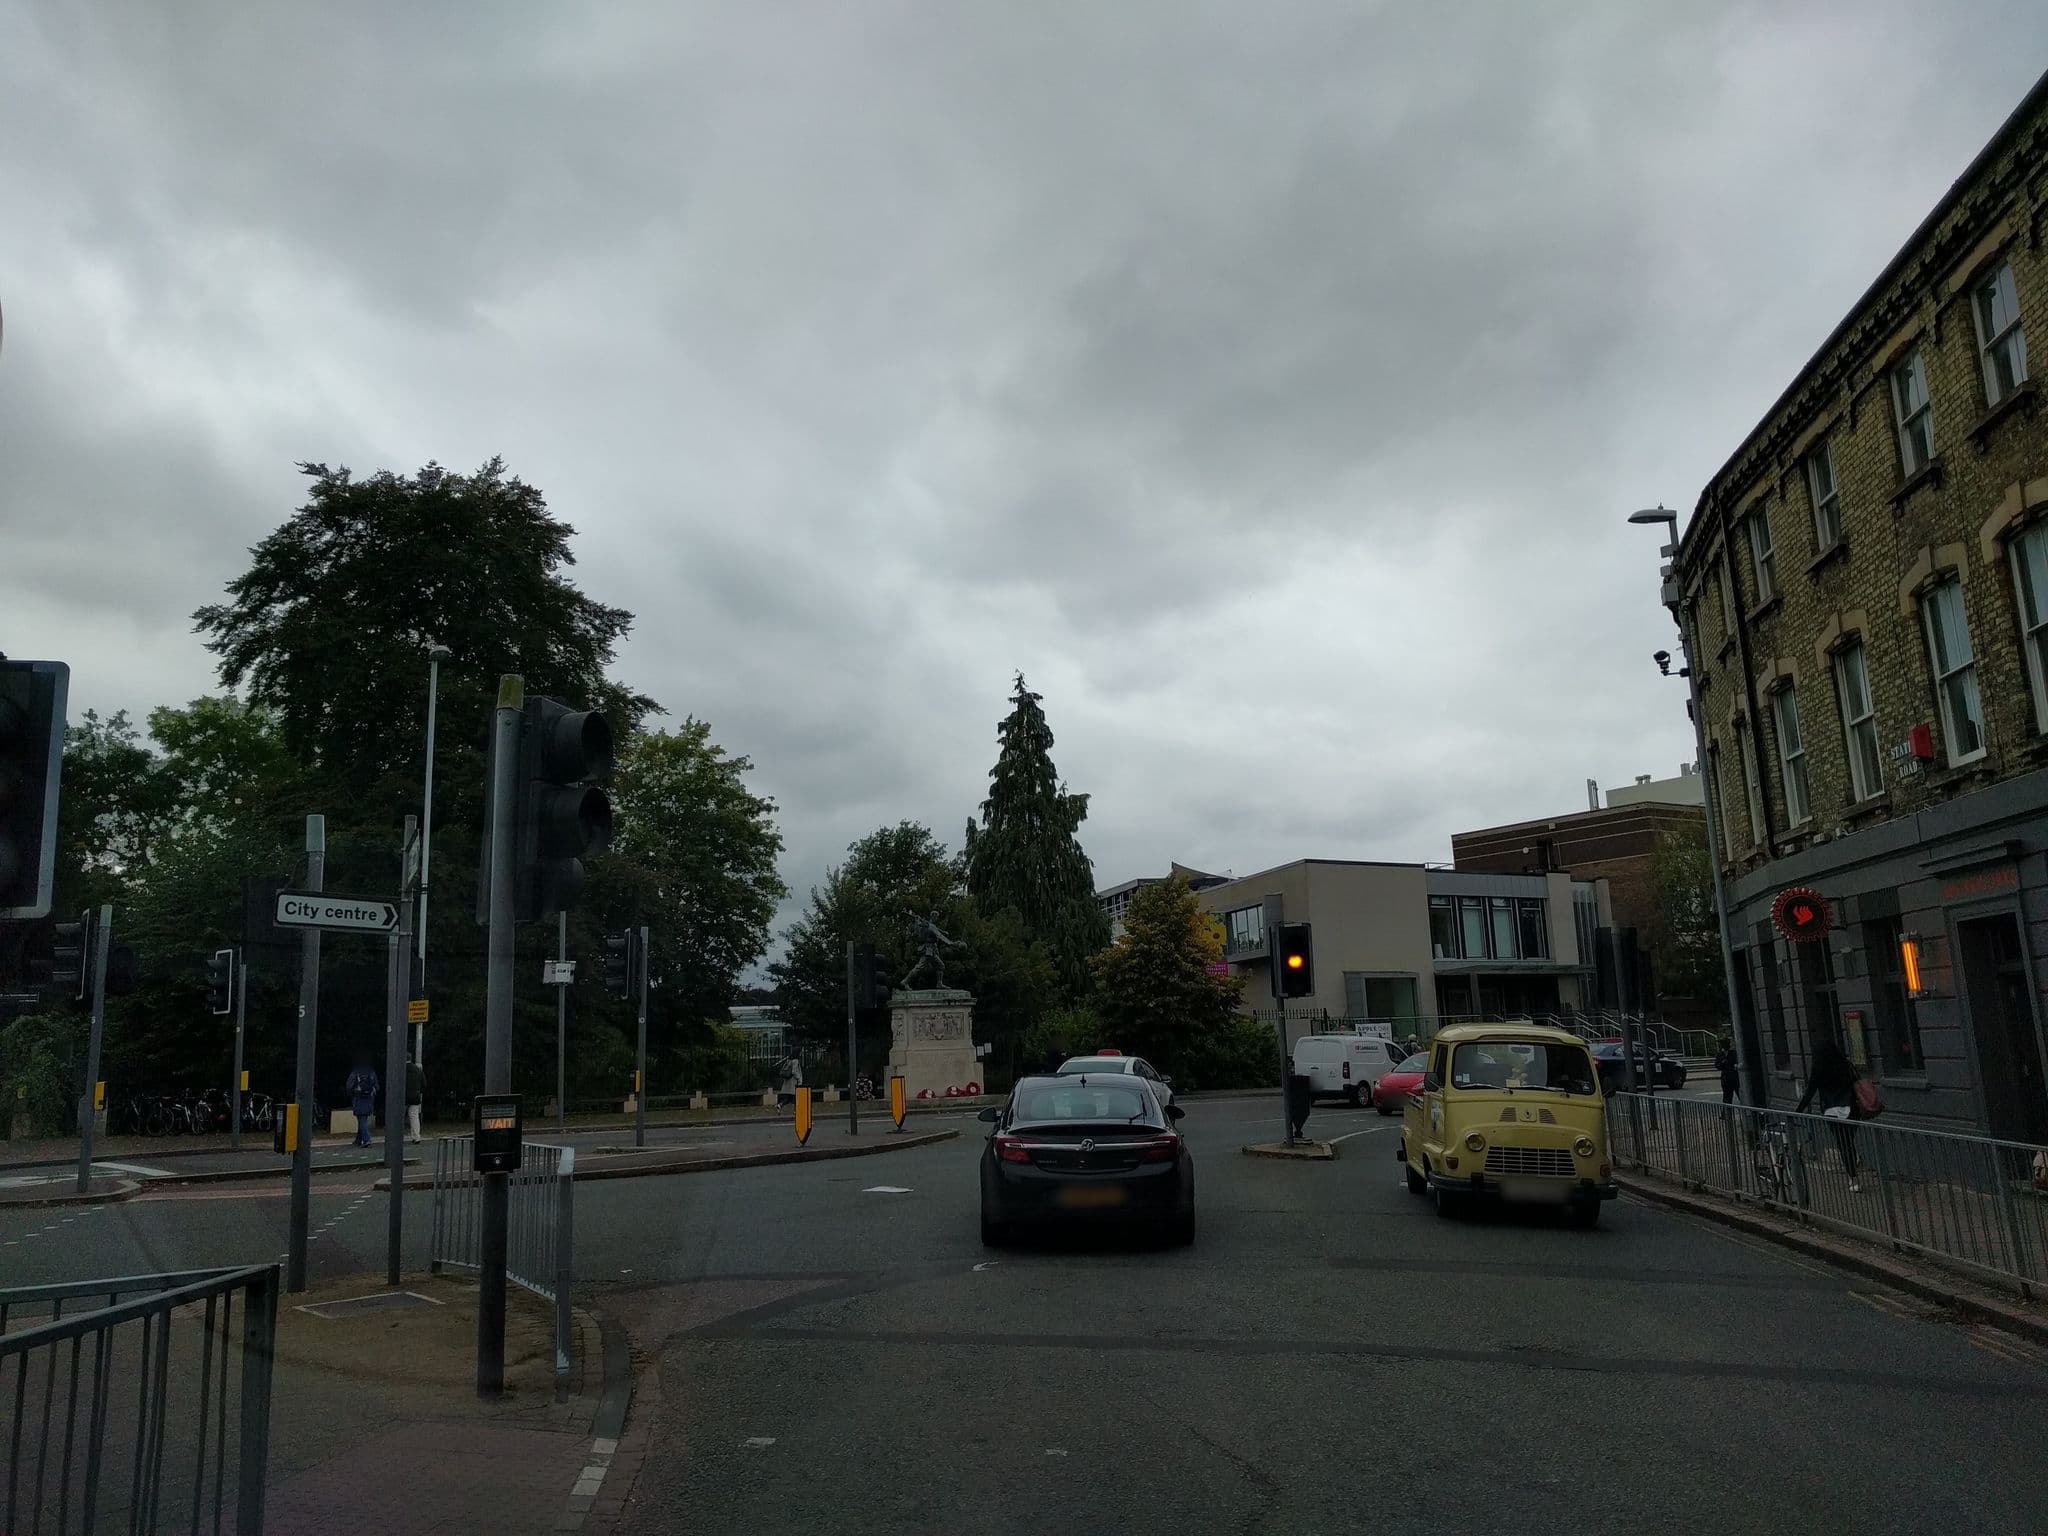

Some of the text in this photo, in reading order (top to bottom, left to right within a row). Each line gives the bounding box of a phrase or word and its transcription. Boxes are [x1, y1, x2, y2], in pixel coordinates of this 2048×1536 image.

[1899, 761, 1917, 778] ROAD
[284, 901, 378, 921] City centre
[298, 1005, 305, 1018] 5
[484, 1118, 512, 1129] WAIT
